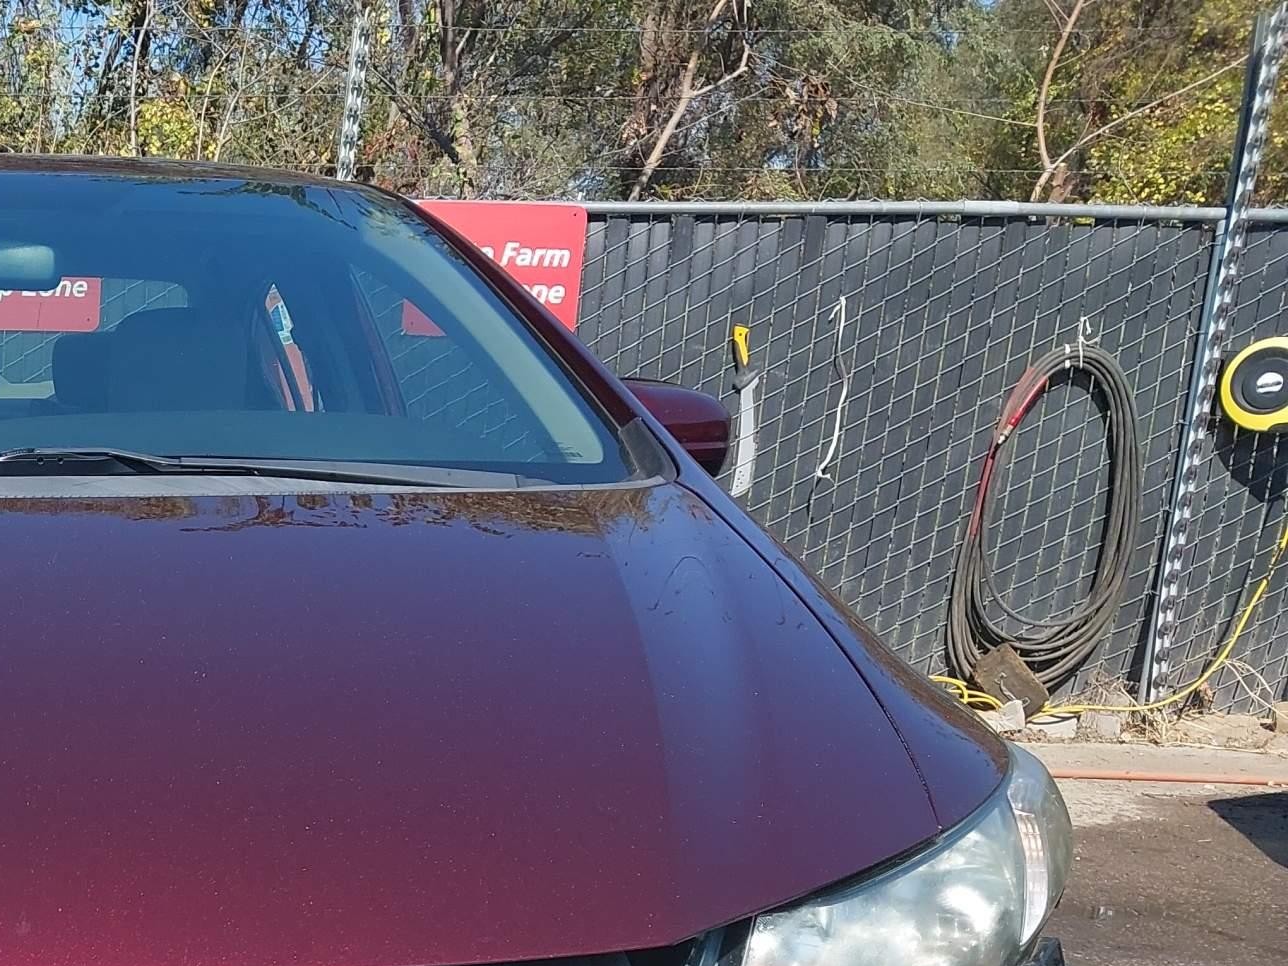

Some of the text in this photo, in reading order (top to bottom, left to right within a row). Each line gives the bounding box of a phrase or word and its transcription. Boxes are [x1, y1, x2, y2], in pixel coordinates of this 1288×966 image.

[501, 242, 571, 267] Farm
[22, 280, 88, 297] ne
[523, 285, 565, 303] ne
